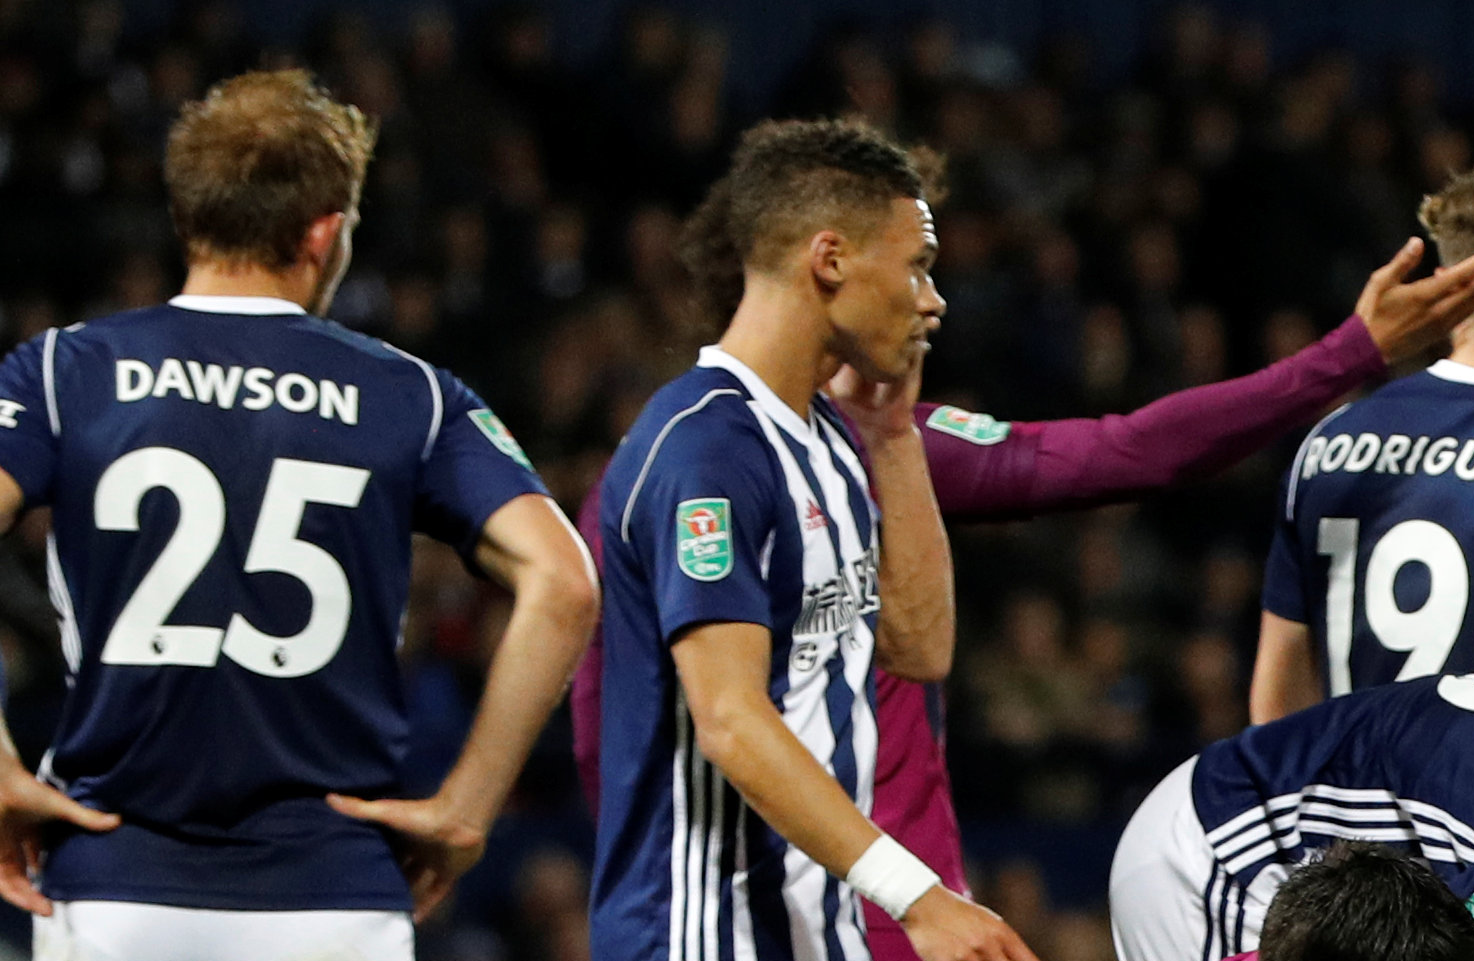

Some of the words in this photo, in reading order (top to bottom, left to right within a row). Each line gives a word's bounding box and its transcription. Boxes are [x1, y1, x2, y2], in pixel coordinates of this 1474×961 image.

[115, 358, 360, 426] DAWSON
[94, 446, 372, 679] 25
[1317, 518, 1470, 698] 19
